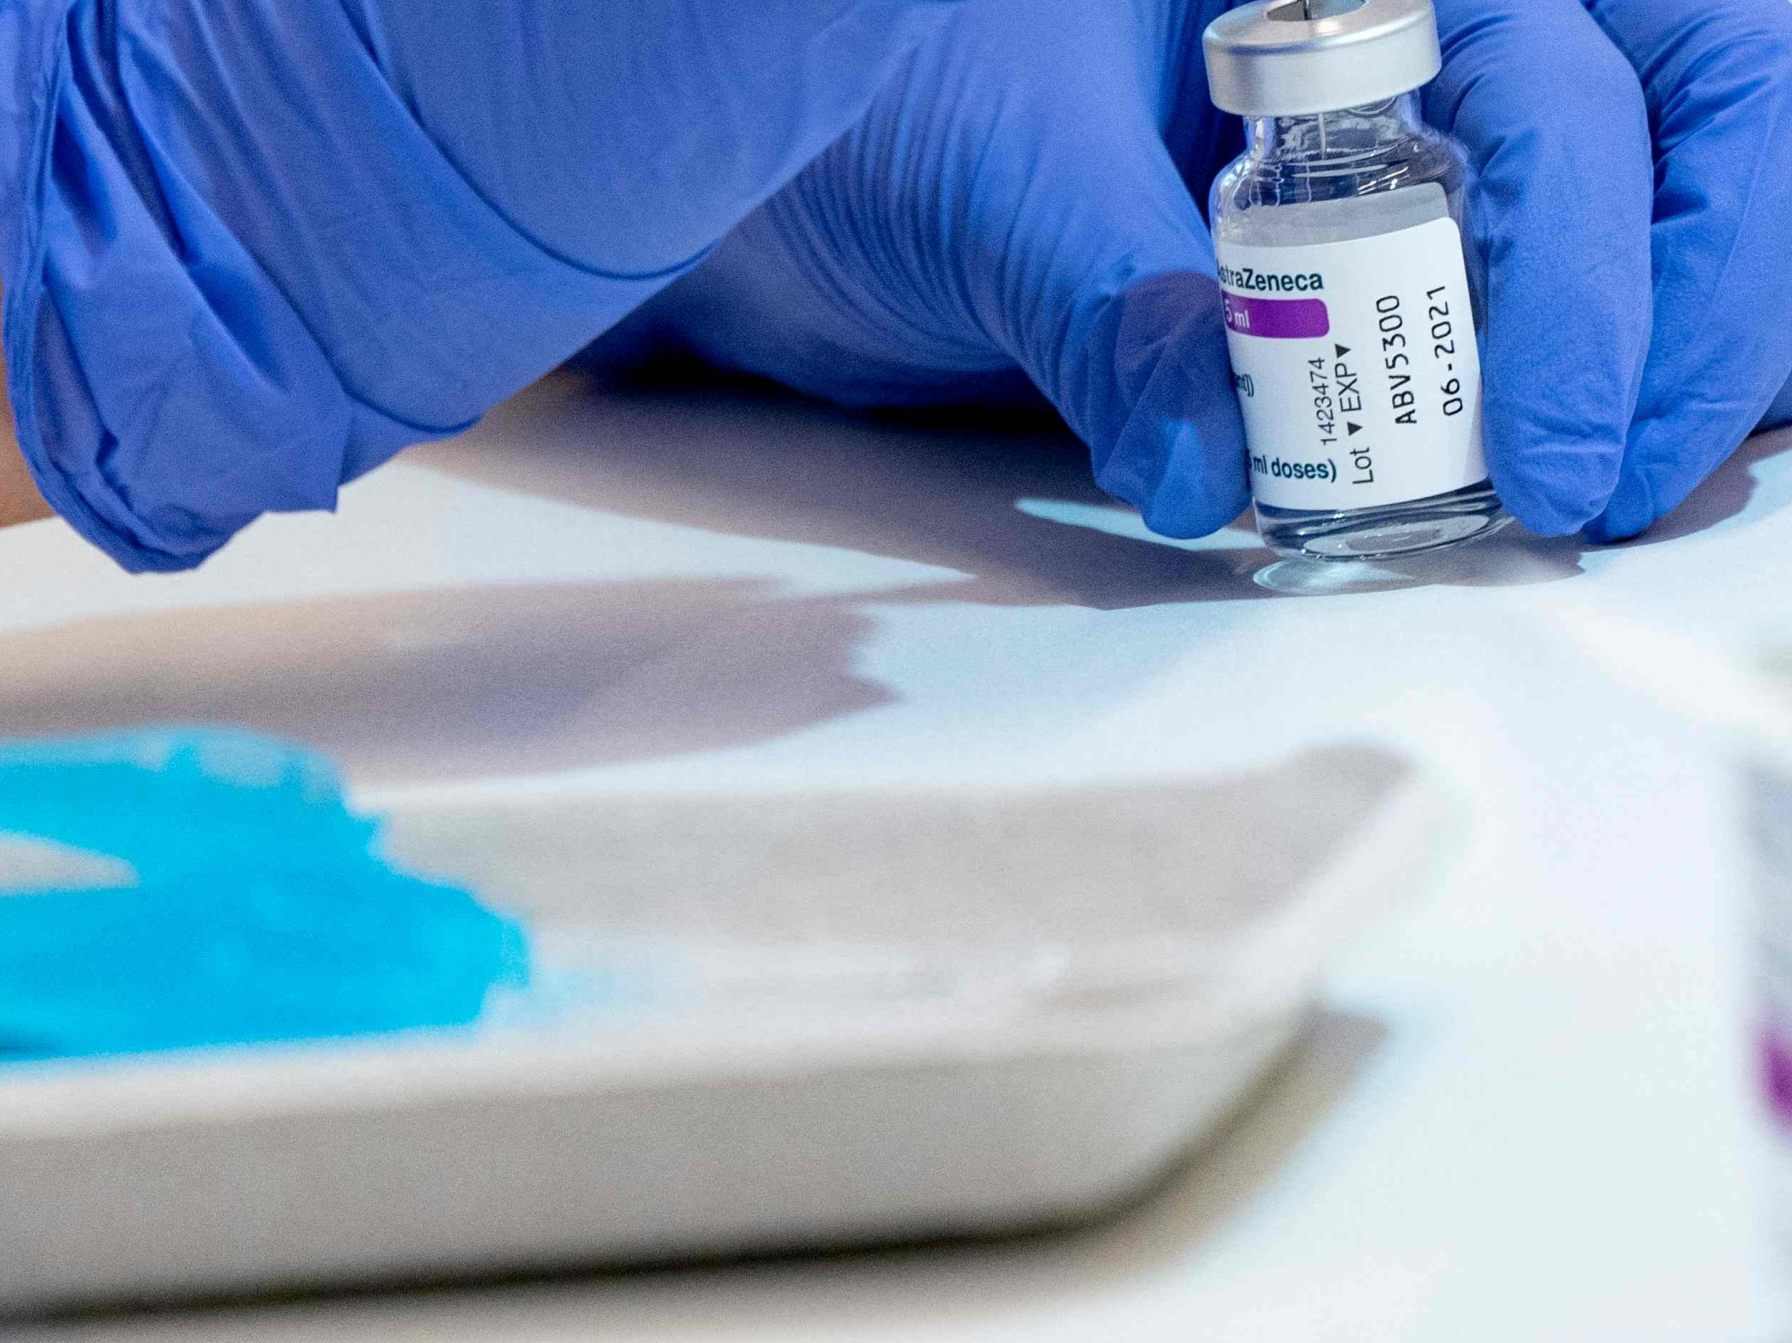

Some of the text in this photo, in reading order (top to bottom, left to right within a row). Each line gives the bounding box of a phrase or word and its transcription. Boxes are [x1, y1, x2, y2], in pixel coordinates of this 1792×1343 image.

[1234, 309, 1250, 330] ml
[1376, 295, 1417, 424] ABV5300
[1426, 286, 1463, 416] 06-2021
[1308, 357, 1337, 445] 1423474
[1334, 362, 1374, 485] Lot EXP
[1253, 455, 1337, 483] ml doses)
